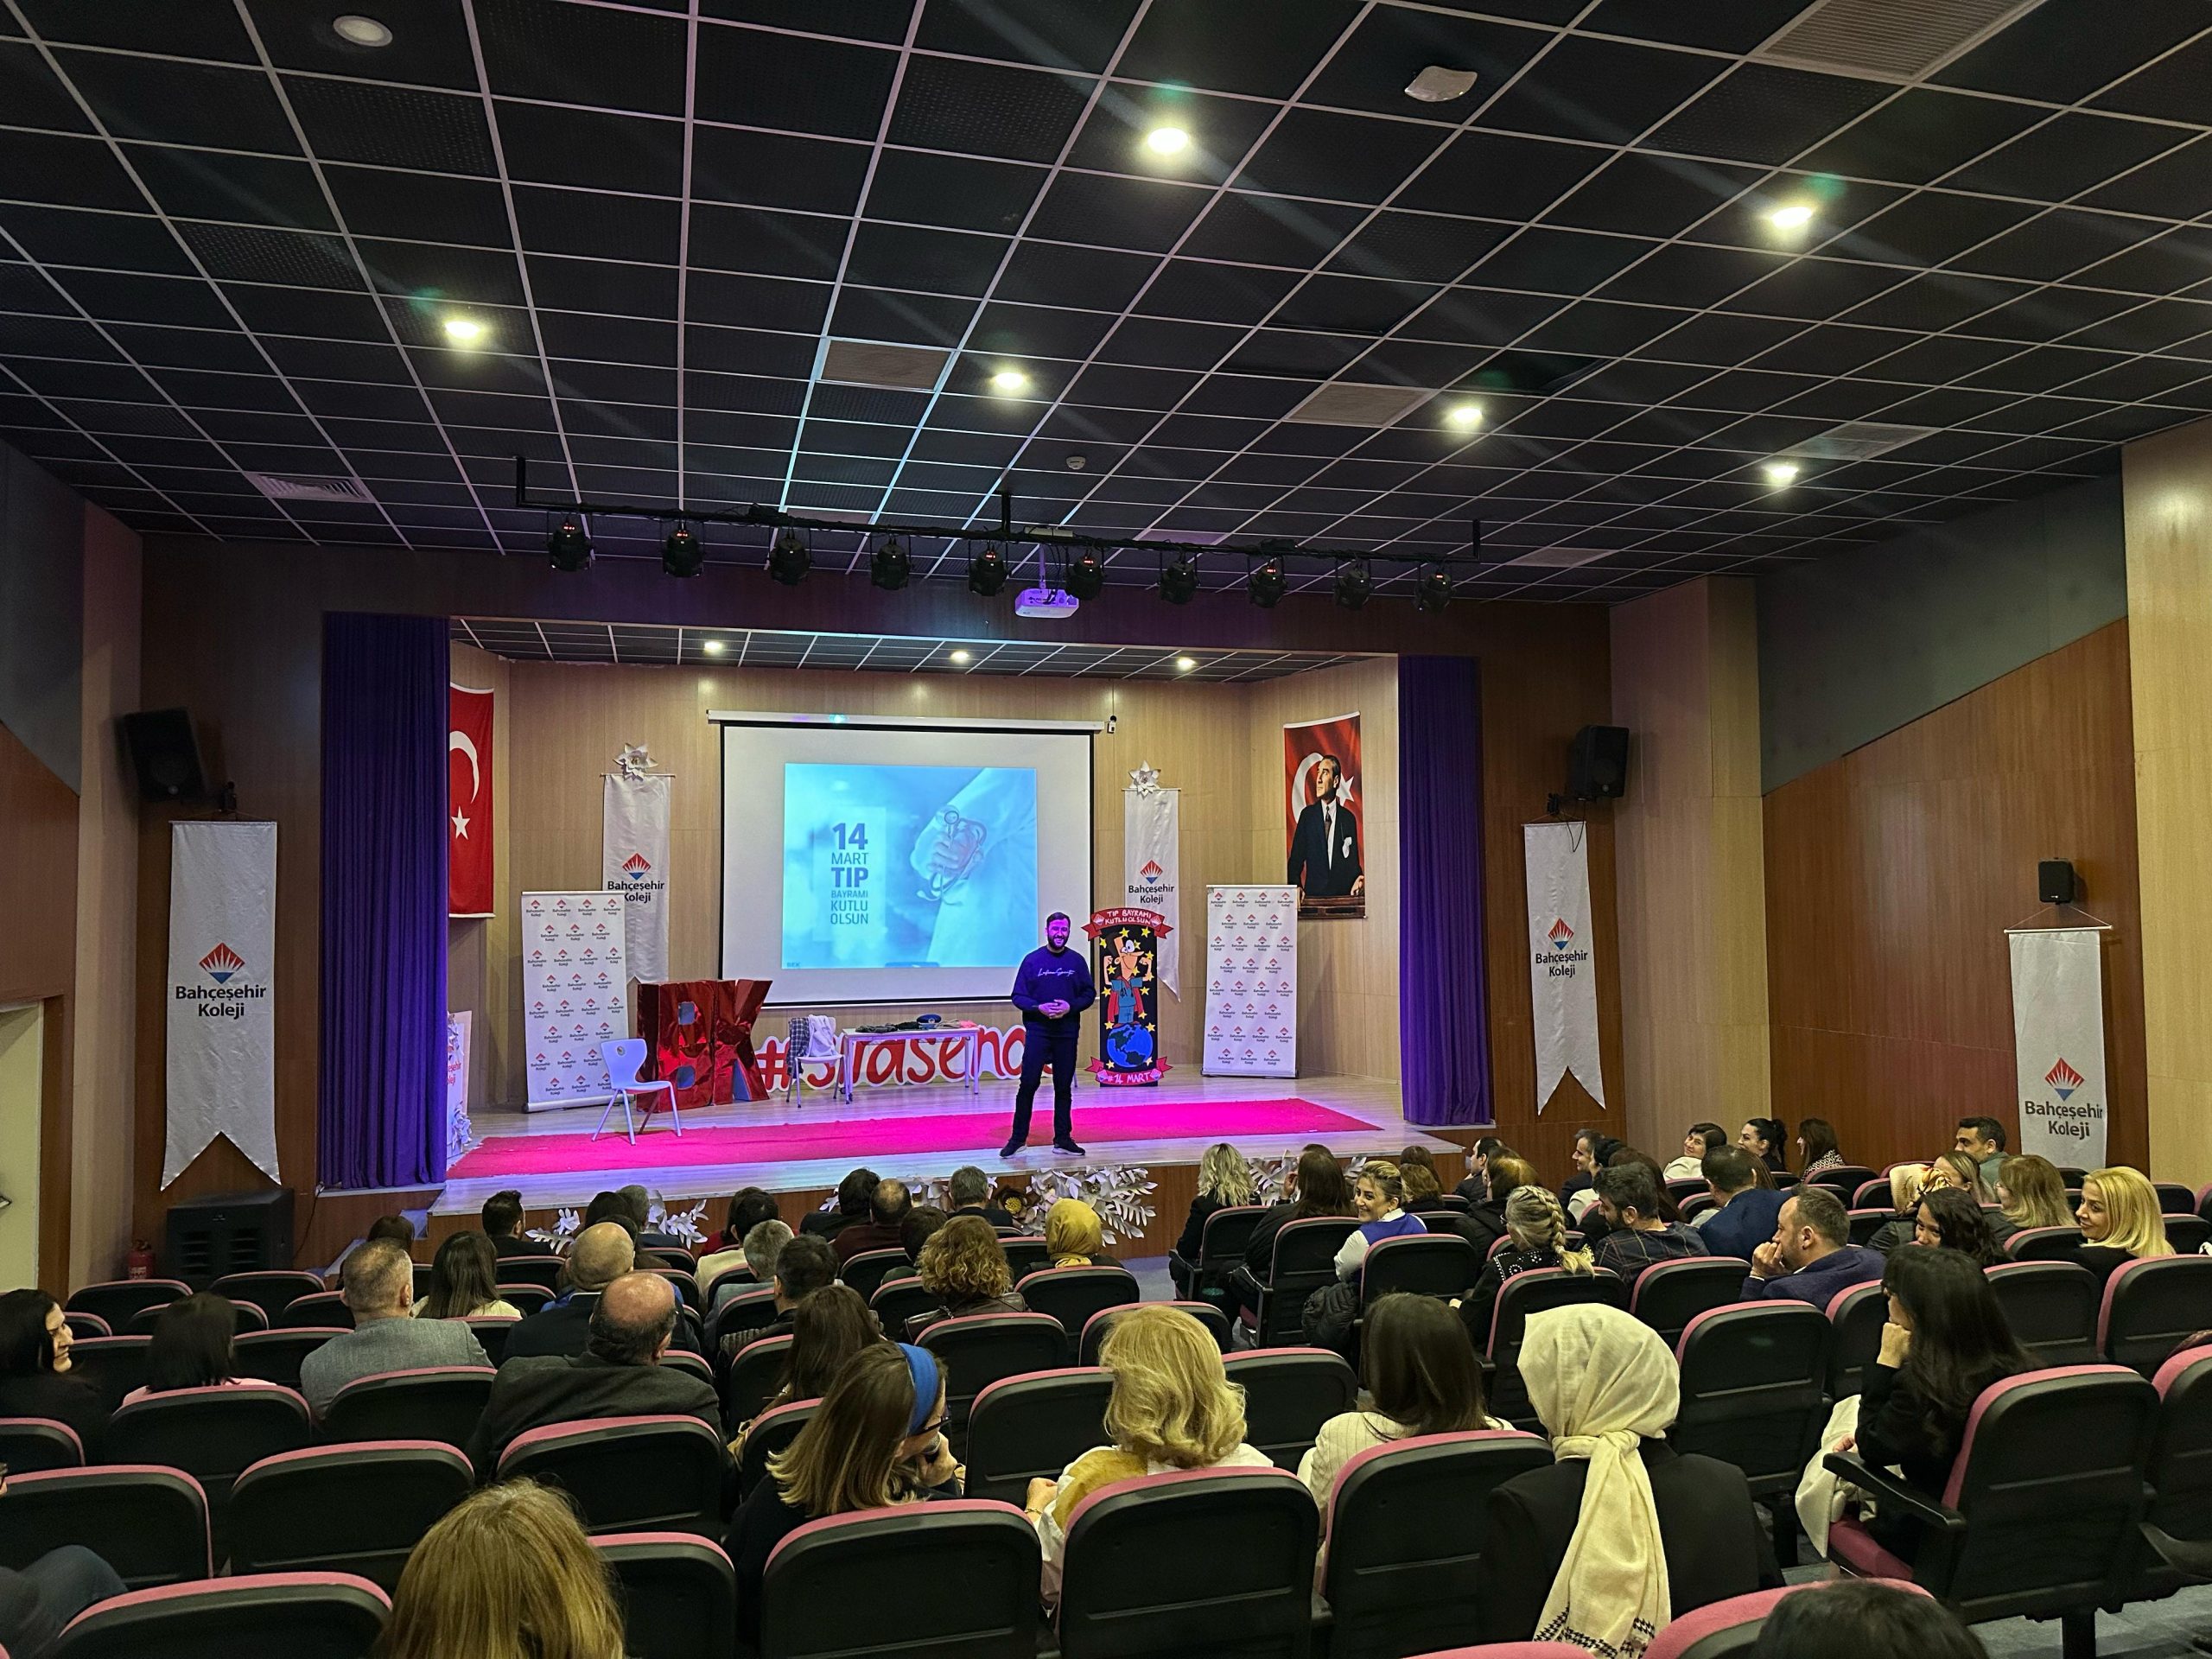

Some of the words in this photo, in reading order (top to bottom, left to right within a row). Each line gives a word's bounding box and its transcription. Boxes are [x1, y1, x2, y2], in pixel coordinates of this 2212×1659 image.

[832, 823, 868, 850] 14
[831, 852, 868, 865] MART
[831, 867, 868, 887] TIP
[607, 880, 664, 891] Bahçeşehir
[1128, 883, 1174, 893] Bahçeşehir
[831, 890, 868, 899] BAYRAMI
[1140, 894, 1163, 905] Koleji
[831, 900, 868, 912] KUTLU
[830, 912, 868, 925] OLSUN
[1535, 950, 1588, 964] Bahçeşehir
[1549, 964, 1575, 978] Koleji
[175, 985, 266, 1001] Bahçeşehir
[198, 1002, 245, 1020] Koleji
[1127, 1072, 1151, 1084] MART
[2024, 1101, 2103, 1120] Bahçeşehir
[2048, 1121, 2090, 1141] Koleji
